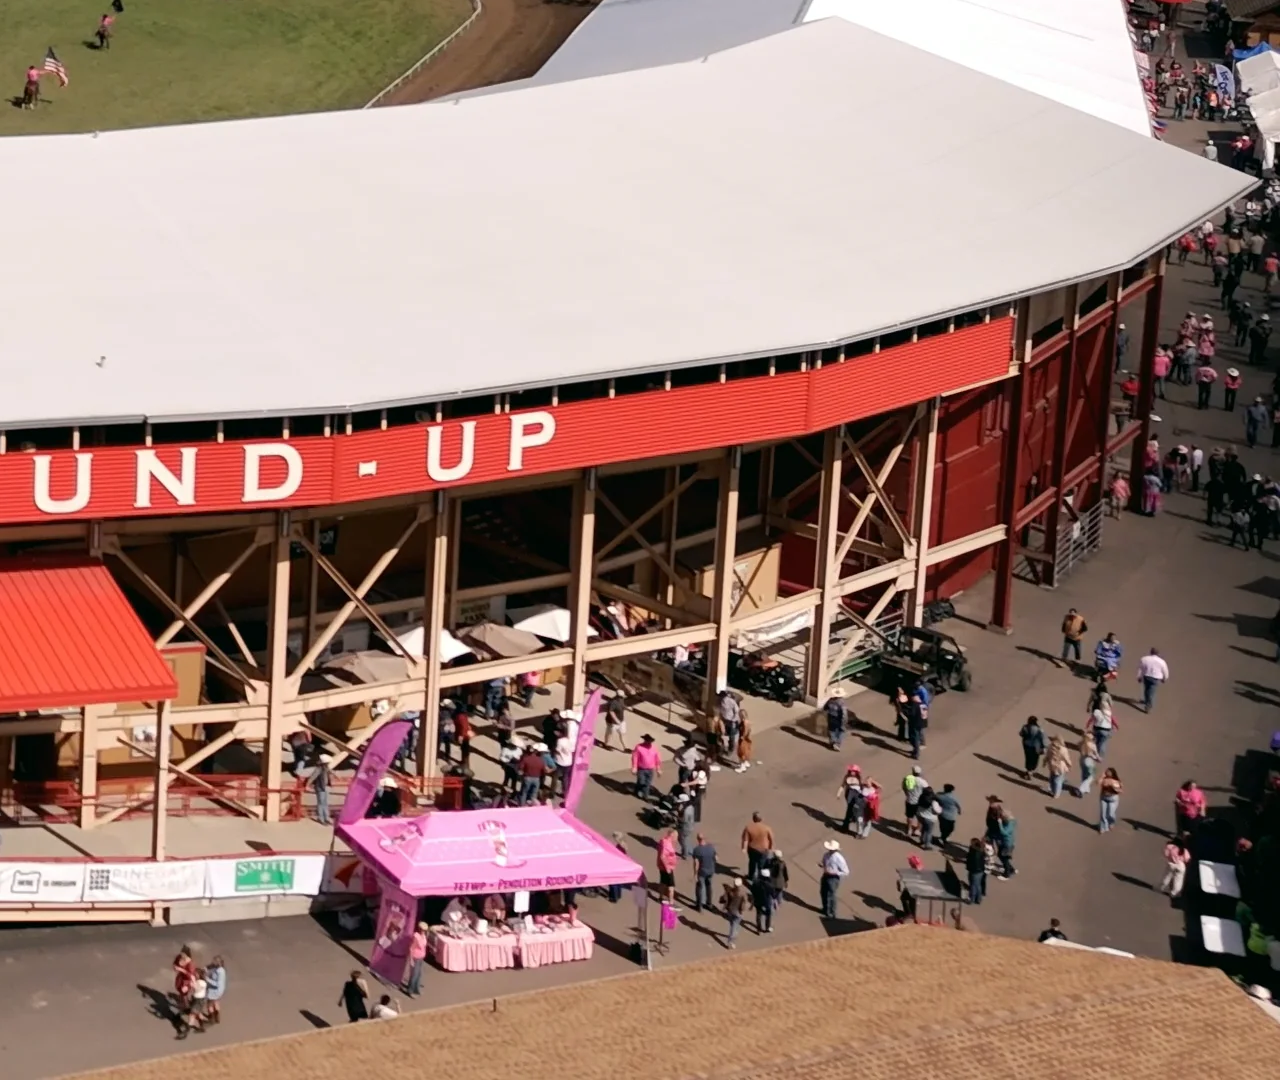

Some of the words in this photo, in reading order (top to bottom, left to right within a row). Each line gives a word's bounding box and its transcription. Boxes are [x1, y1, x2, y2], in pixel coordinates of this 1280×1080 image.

[237, 860, 292, 877] SMITH
[498, 877, 542, 890] PENDLETON
[545, 873, 588, 887] ROUND-UP
